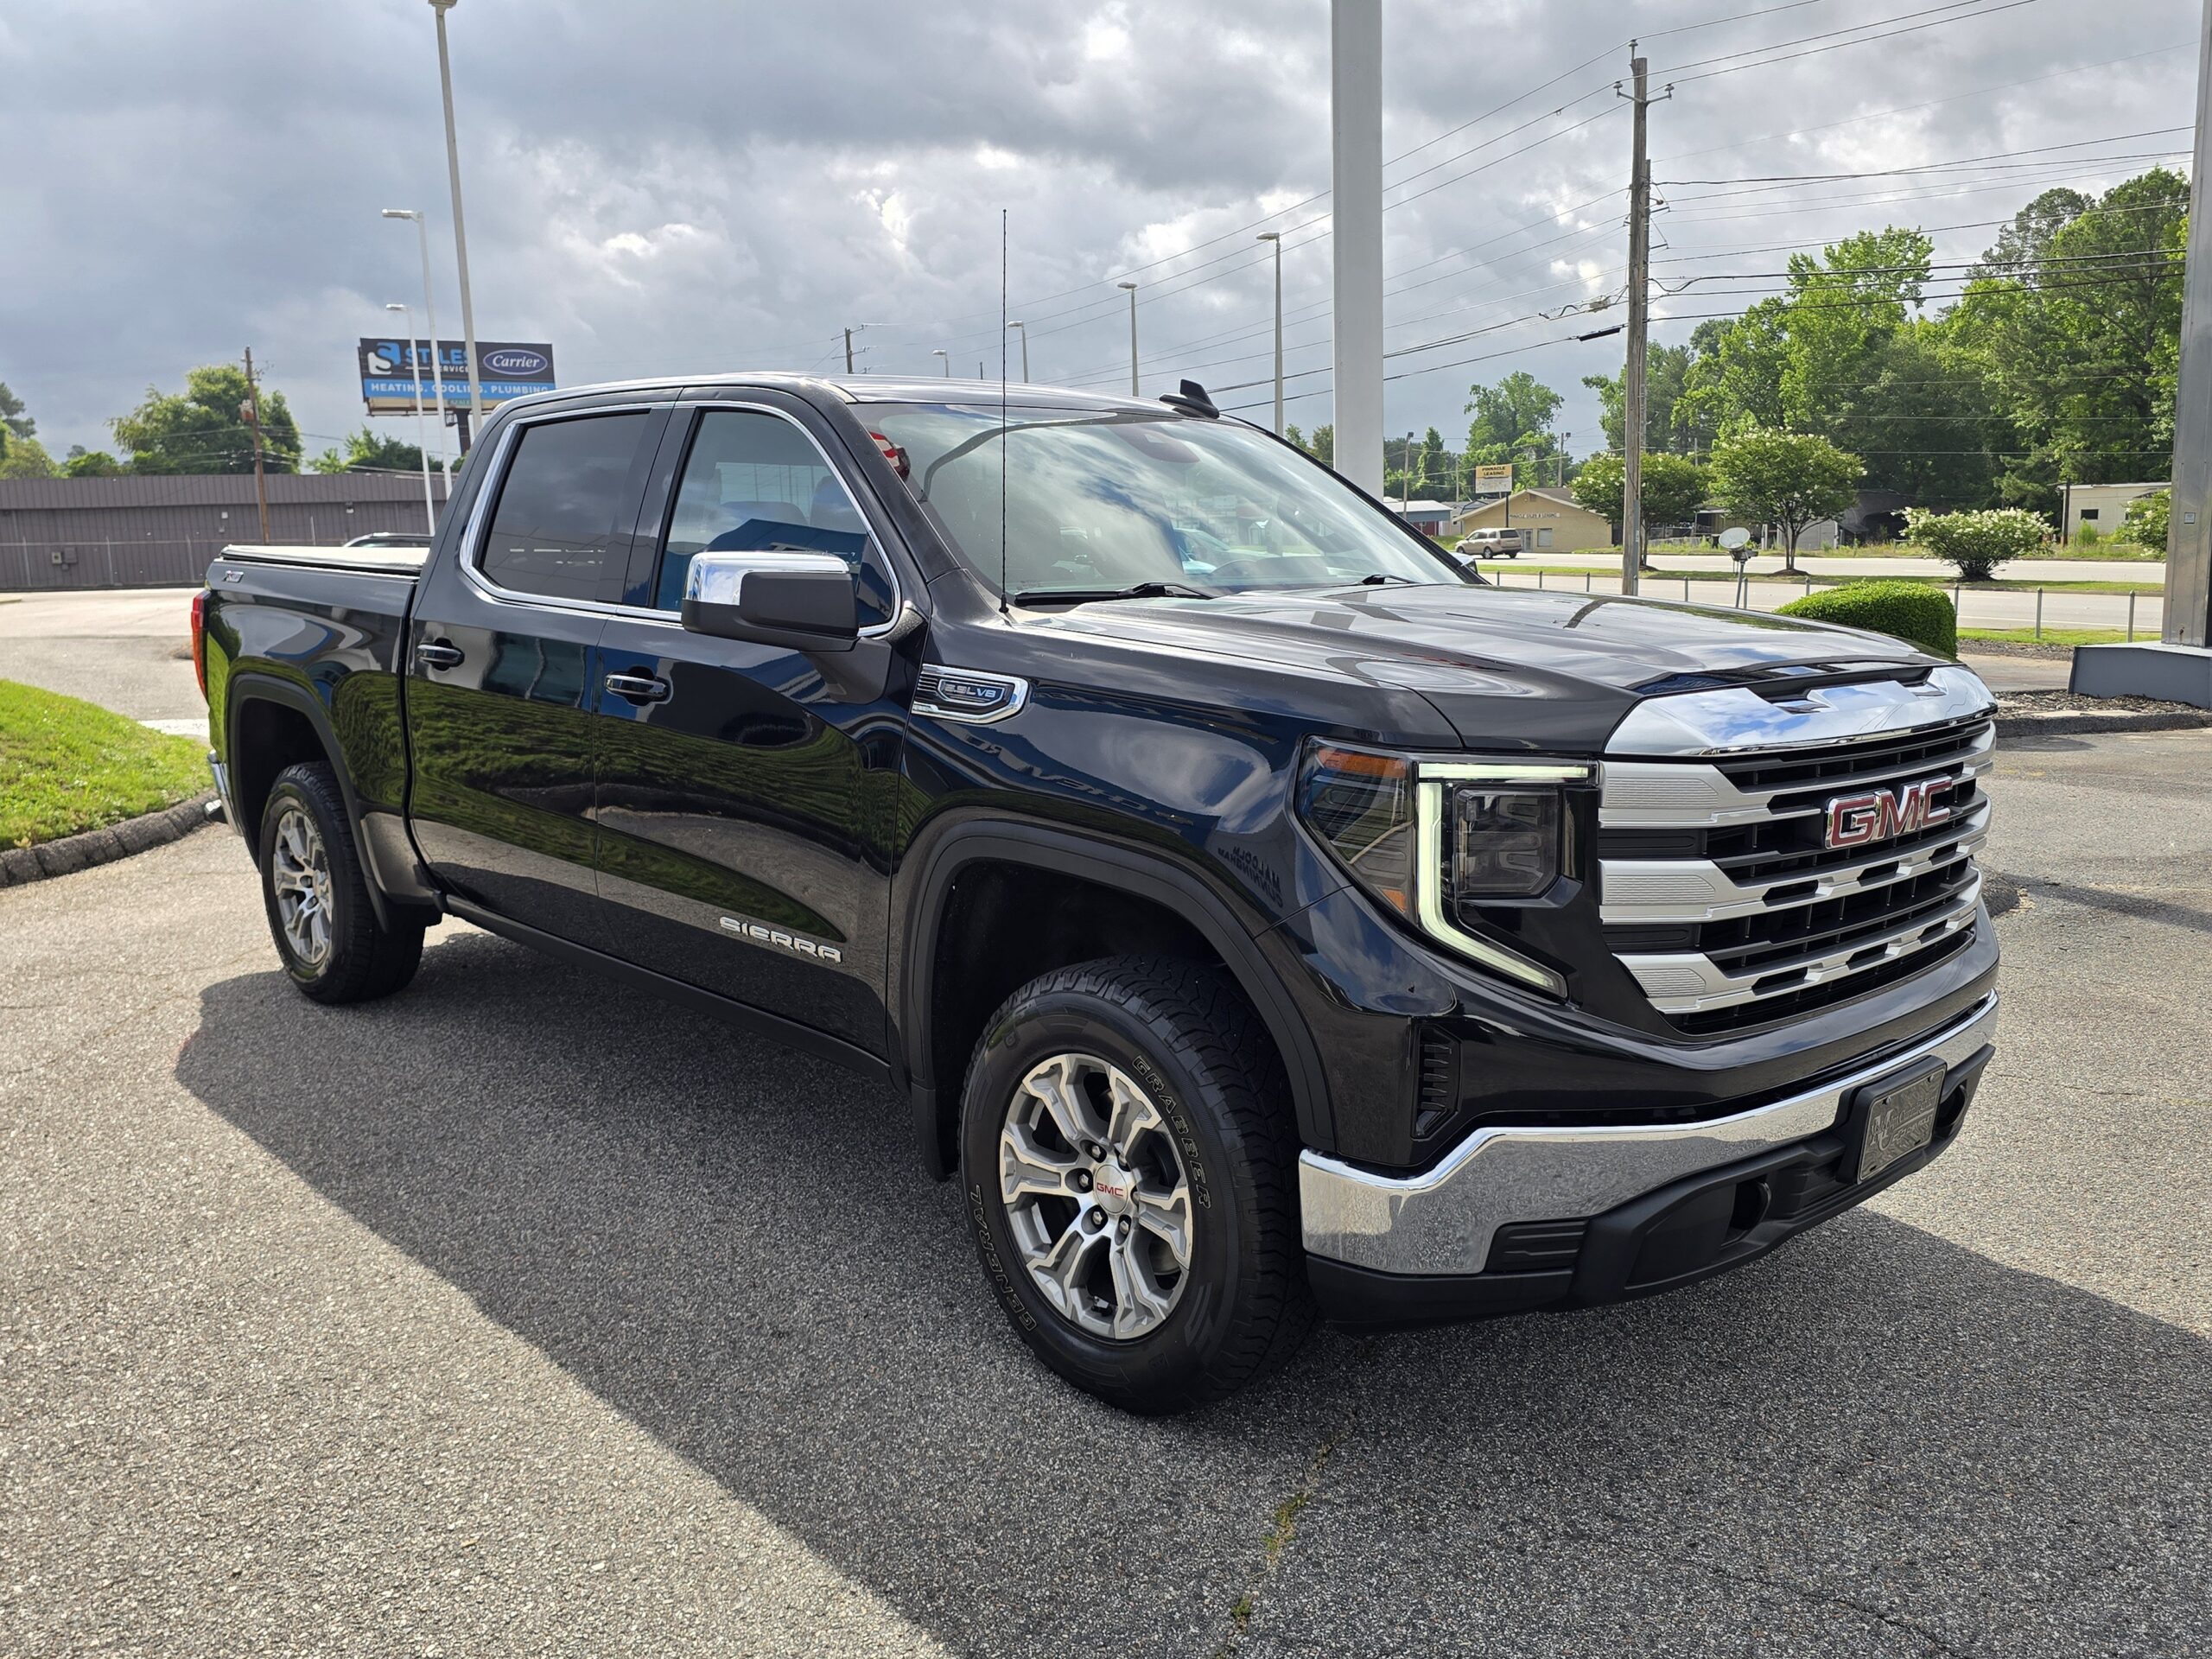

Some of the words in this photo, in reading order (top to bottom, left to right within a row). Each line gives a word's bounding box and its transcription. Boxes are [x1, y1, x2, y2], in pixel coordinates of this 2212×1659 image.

[404, 346, 471, 365] STLE
[492, 354, 540, 367] Carrier
[431, 384, 487, 393] COOLI.
[1825, 774, 1953, 850] GMC
[719, 916, 842, 963] SIERRA
[1132, 1055, 1211, 1209] GRABBER
[1096, 1182, 1123, 1197] GMC
[970, 1185, 1037, 1332] GENERAL
